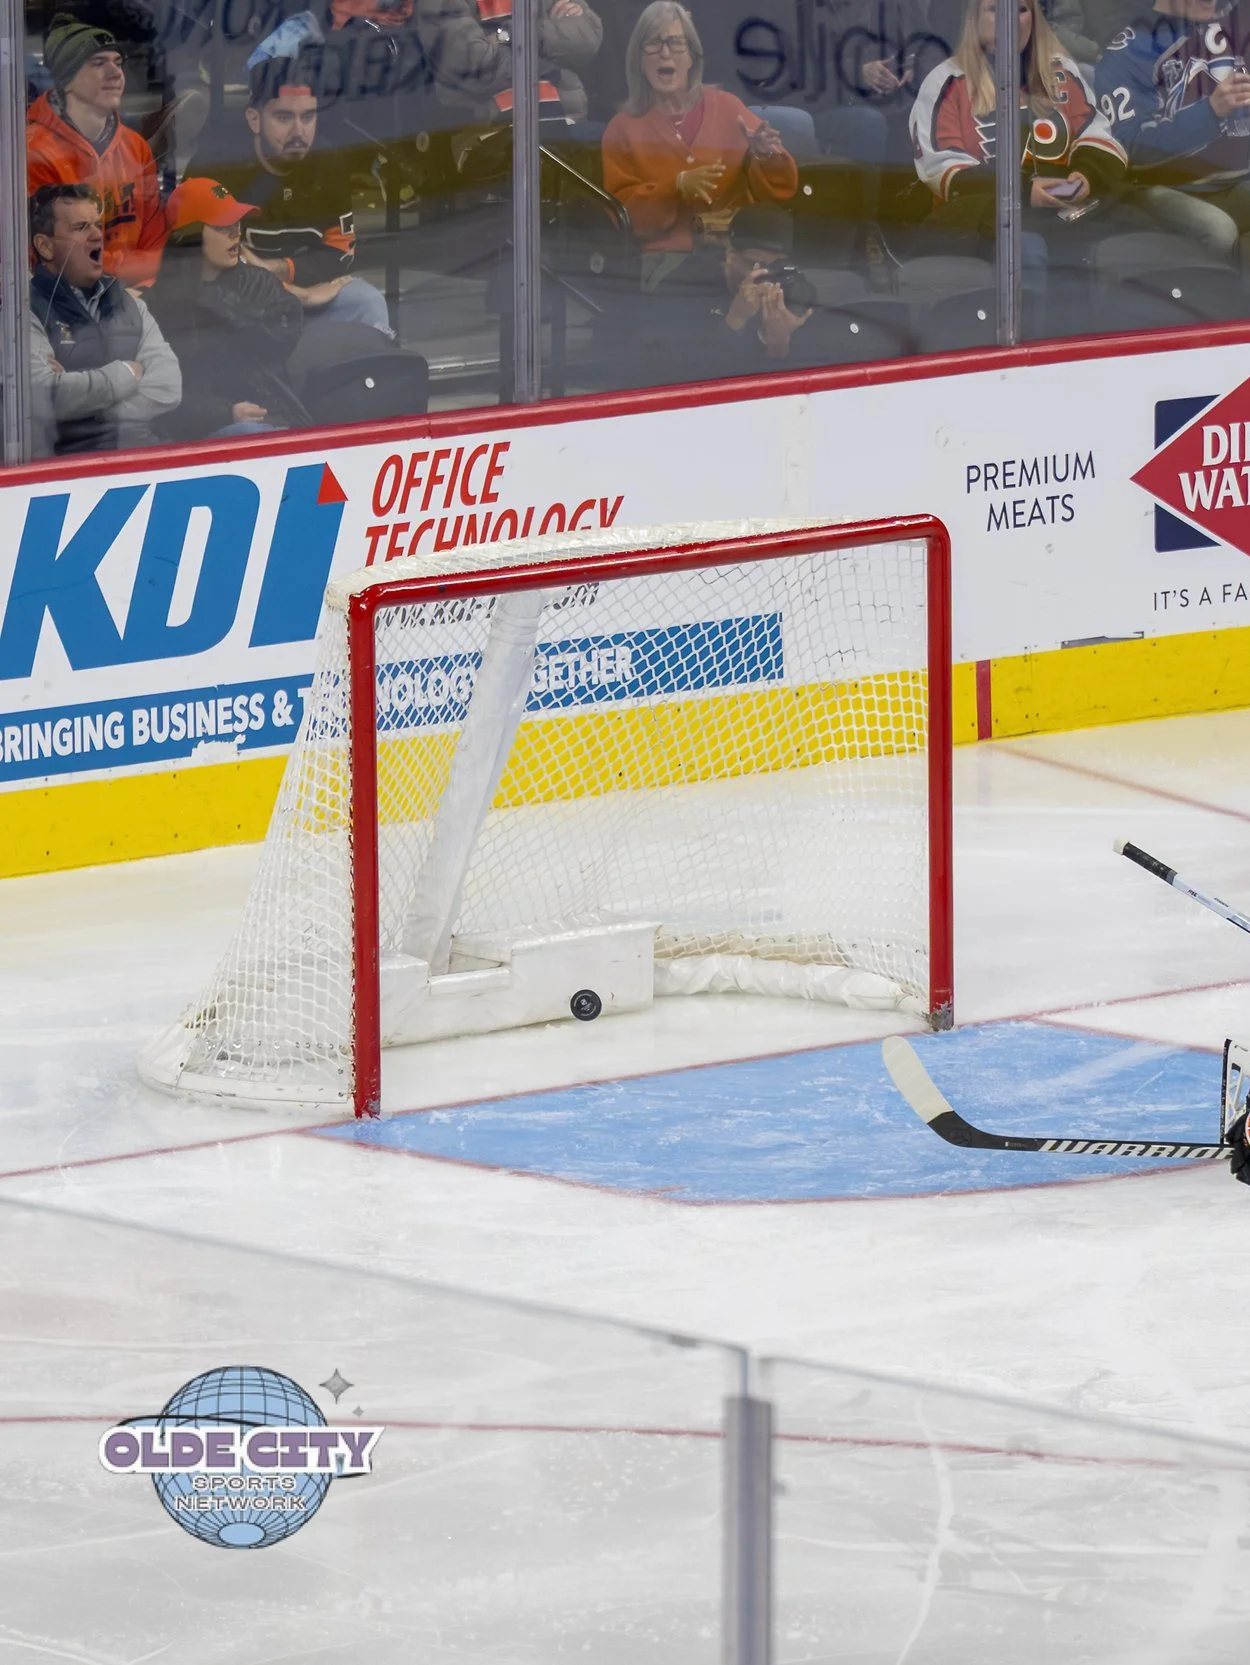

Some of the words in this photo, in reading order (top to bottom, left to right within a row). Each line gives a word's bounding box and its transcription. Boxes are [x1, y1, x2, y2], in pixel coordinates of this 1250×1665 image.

[1101, 87, 1136, 126] 92
[371, 441, 511, 518] OFFICE
[965, 450, 1096, 494] PREMIUM
[986, 494, 1075, 532] MEATS
[0, 462, 348, 681] KDI
[1153, 588, 1189, 611] IT'S
[1198, 586, 1212, 606] A
[132, 693, 265, 746] BUSINESS
[272, 689, 294, 727] &
